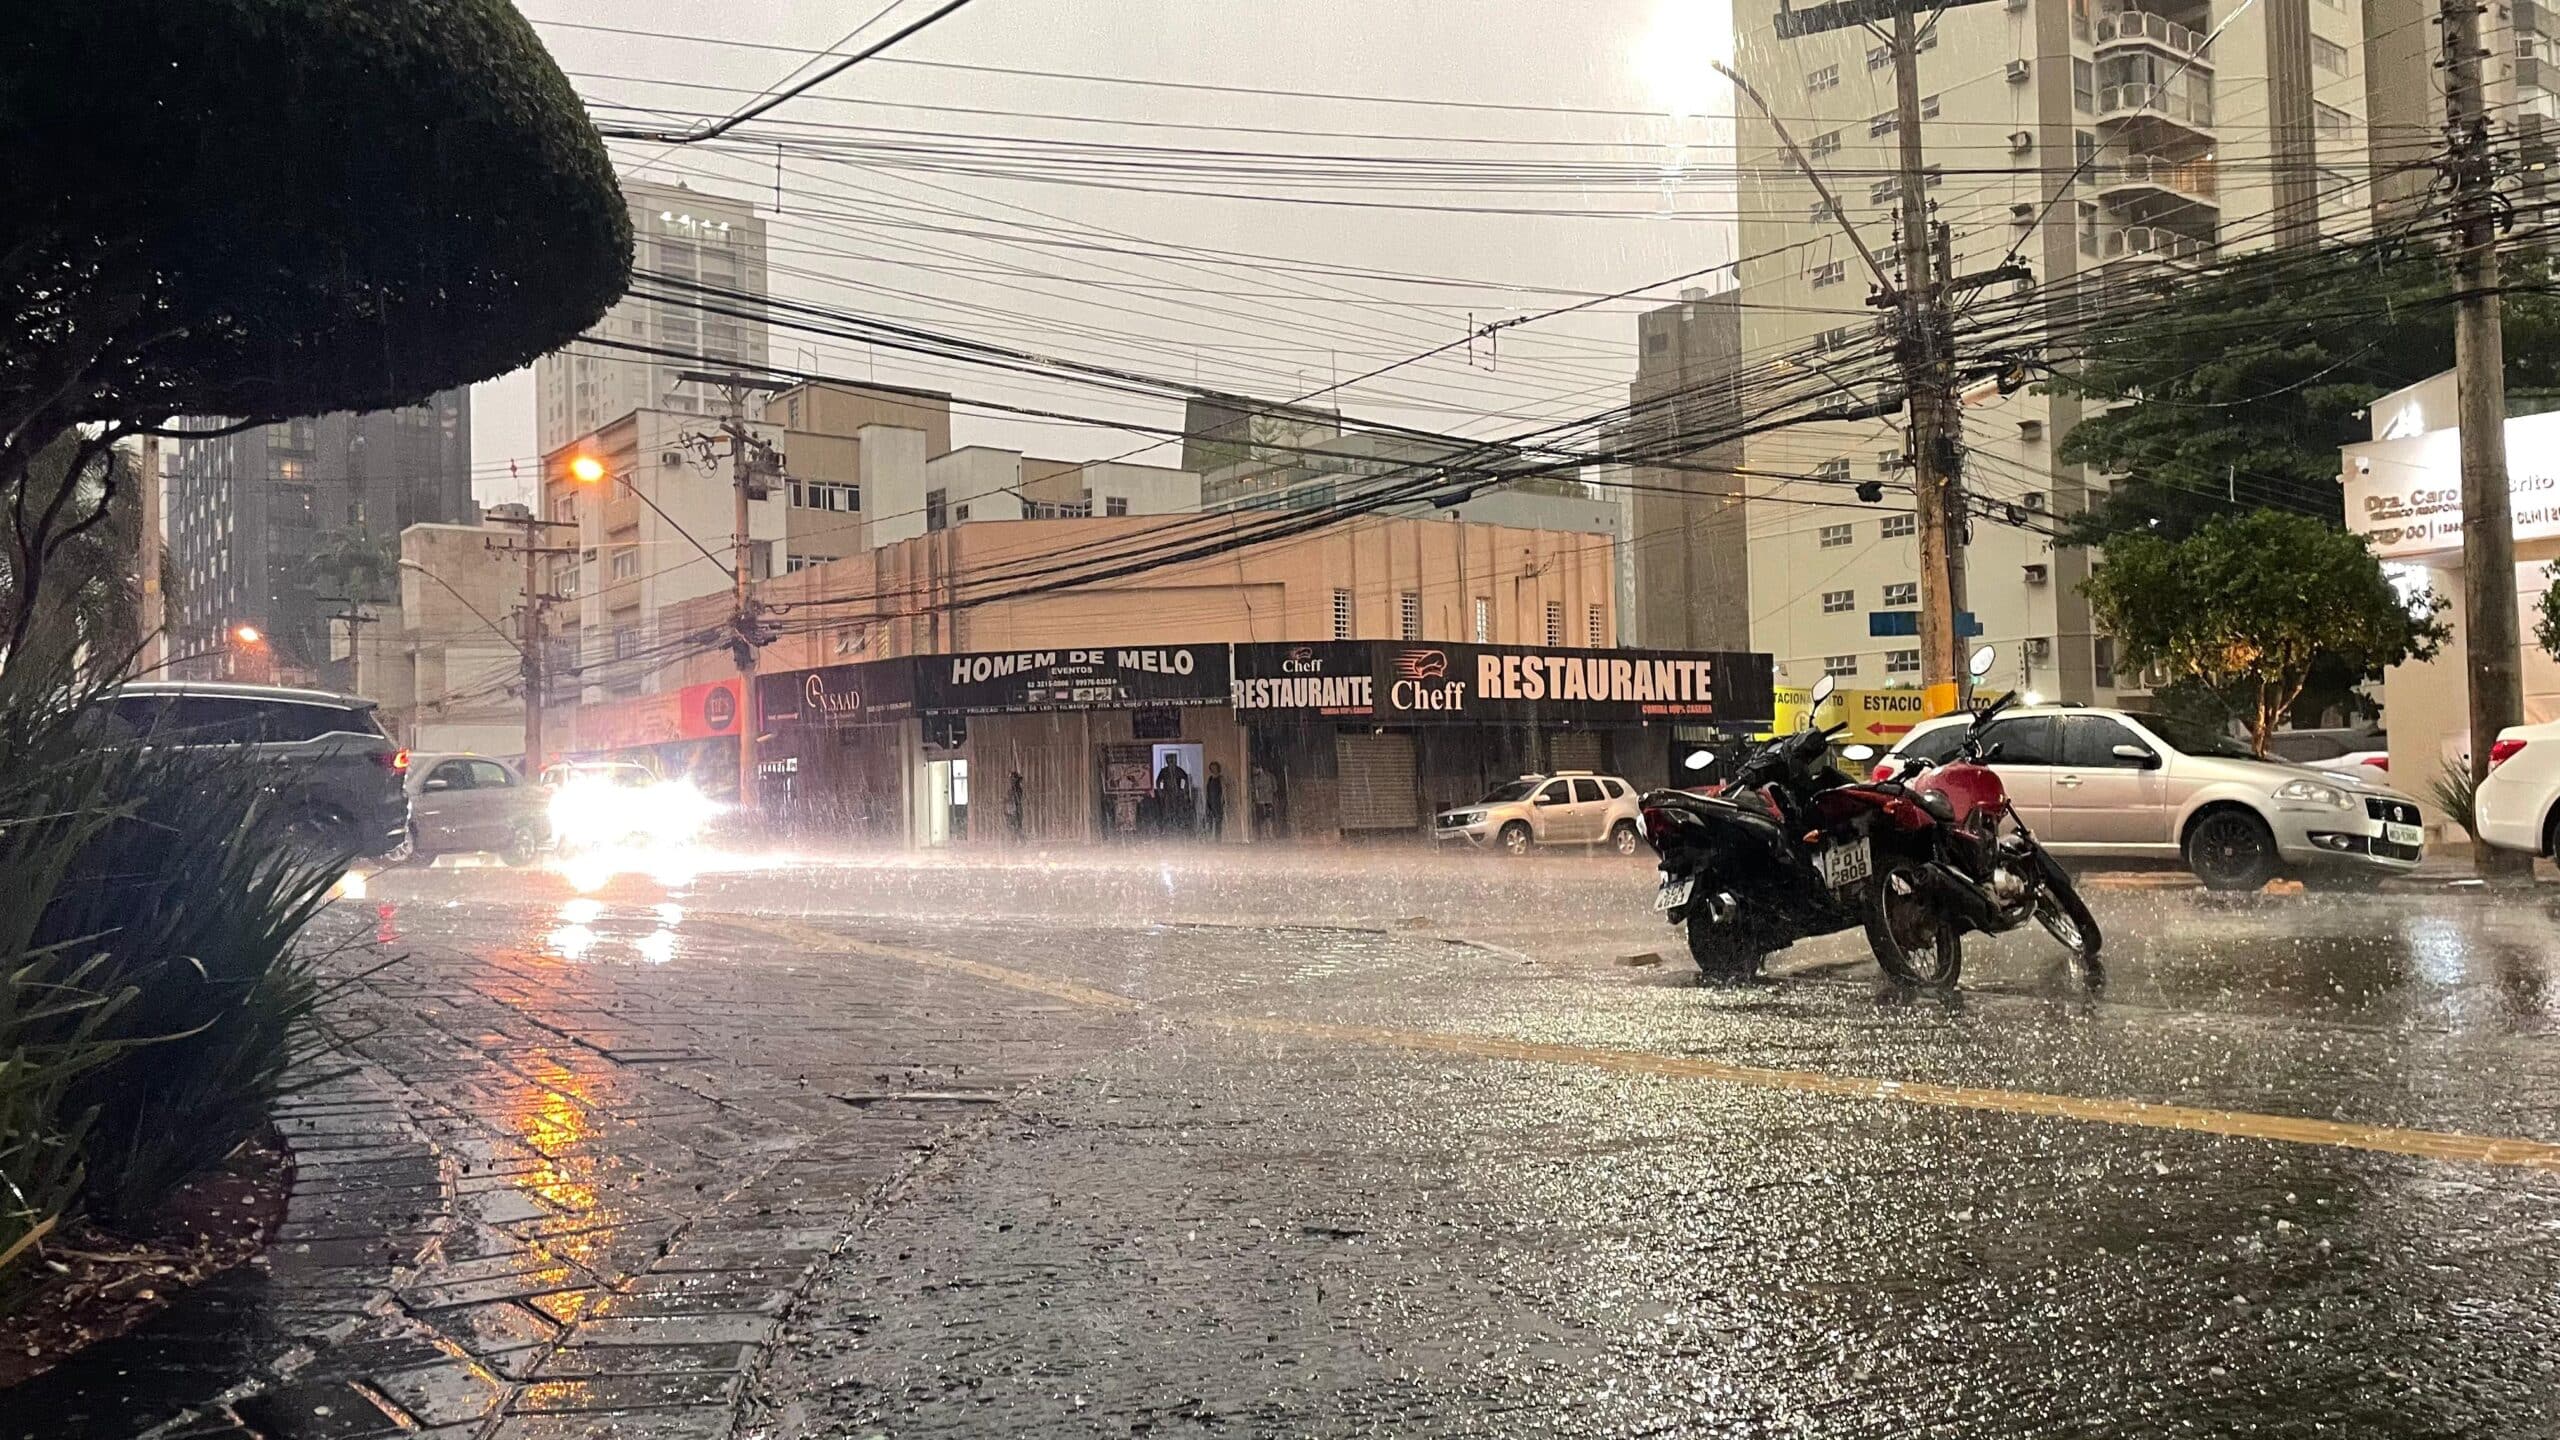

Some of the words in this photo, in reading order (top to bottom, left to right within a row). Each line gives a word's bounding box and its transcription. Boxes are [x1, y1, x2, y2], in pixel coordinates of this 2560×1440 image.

[2411, 489, 2458, 505] Caro
[952, 652, 1056, 684] HOMEM
[1069, 650, 1105, 665] DE
[1118, 650, 1194, 675] MELO
[1051, 666, 1093, 675] EVENTOS
[1282, 659, 1323, 673] Cheff
[1478, 654, 1712, 701] RESTAURANTE
[1234, 676, 1373, 709] RESTAURANTE
[1391, 680, 1465, 711] Cheff
